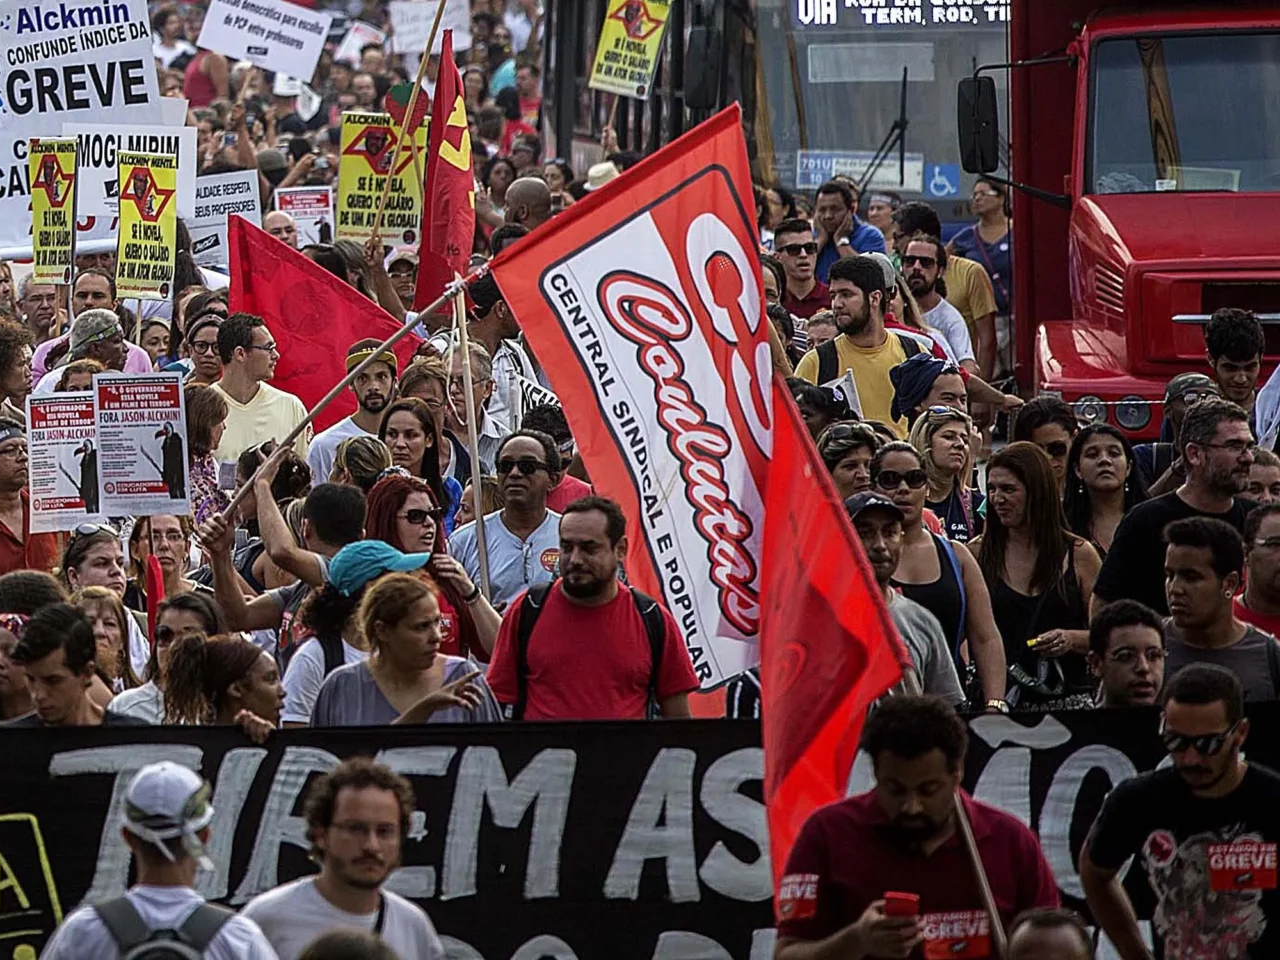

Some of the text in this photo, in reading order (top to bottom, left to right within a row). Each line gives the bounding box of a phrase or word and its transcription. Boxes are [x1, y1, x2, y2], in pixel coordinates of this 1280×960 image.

[16, 0, 130, 34] Alckmin
[281, 13, 297, 30] para
[297, 15, 324, 36] escolha
[224, 14, 232, 26] de
[247, 22, 265, 37] entre
[265, 28, 304, 50] professores
[7, 21, 149, 66] CONFUNDE ÍNDICE DA
[6, 59, 149, 116] GREVE
[345, 114, 390, 127] ALCKMIN
[222, 181, 252, 195] RESPEITA
[357, 176, 367, 191] SE
[368, 173, 373, 191] É
[195, 200, 256, 218] SEUS PROFESSORES
[347, 194, 373, 210] QUERO
[340, 211, 349, 226] DE
[351, 211, 364, 226] UM
[131, 224, 138, 239] SE
[139, 220, 143, 239] É
[125, 240, 170, 262] QUERO O SALÁRIO
[119, 262, 126, 278] DE
[127, 263, 135, 279] UM
[136, 264, 150, 280] ATOR
[99, 411, 119, 423] FORA
[32, 430, 46, 441] FORA
[597, 270, 762, 637] Conlutas
[549, 272, 714, 682] CENTRAL SINDICAL E POPULAR
[1209, 852, 1278, 870] GREVE
[922, 921, 990, 939] GREVE
